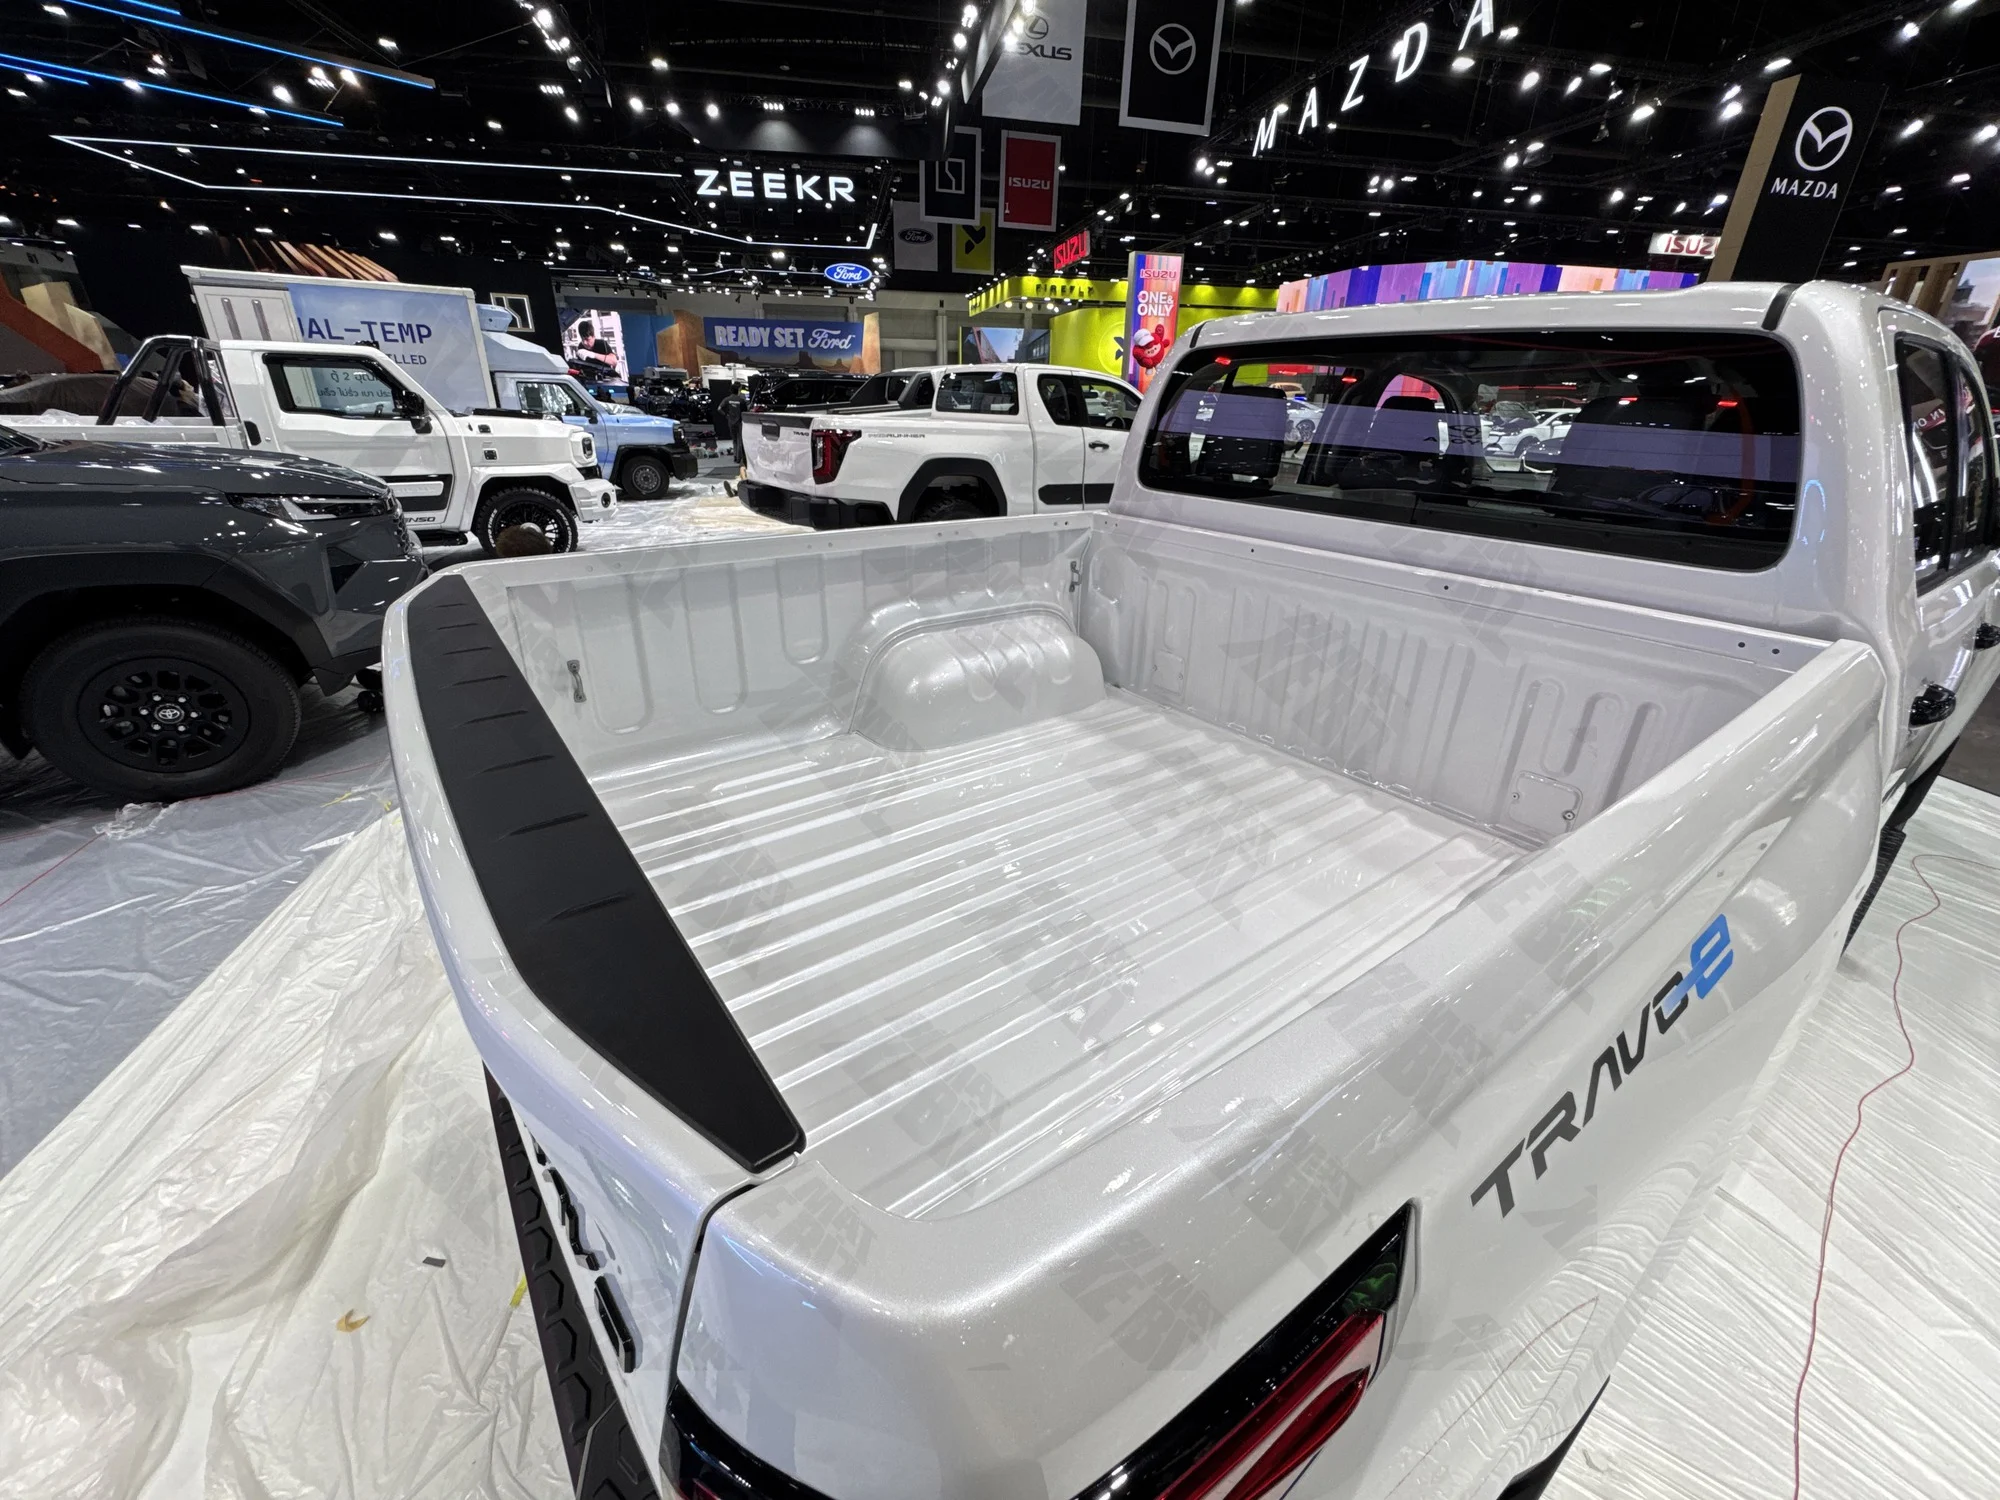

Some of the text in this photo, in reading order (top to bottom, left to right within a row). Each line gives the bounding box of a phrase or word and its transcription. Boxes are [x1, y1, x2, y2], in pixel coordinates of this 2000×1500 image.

[1015, 42, 1072, 61] EXUS
[1252, 0, 1495, 158] MAZDA
[694, 169, 856, 202] ZEEKR
[1008, 176, 1050, 190] ISUZU
[1770, 177, 1839, 200] MAZDA
[904, 229, 928, 243] Ford
[1053, 229, 1088, 270] ISUZU
[1664, 236, 1718, 256] ISUZ
[833, 266, 863, 282] Ford
[1140, 268, 1177, 280] ISUZU
[1137, 303, 1174, 317] ONLY
[714, 325, 856, 350] READY SET Ford
